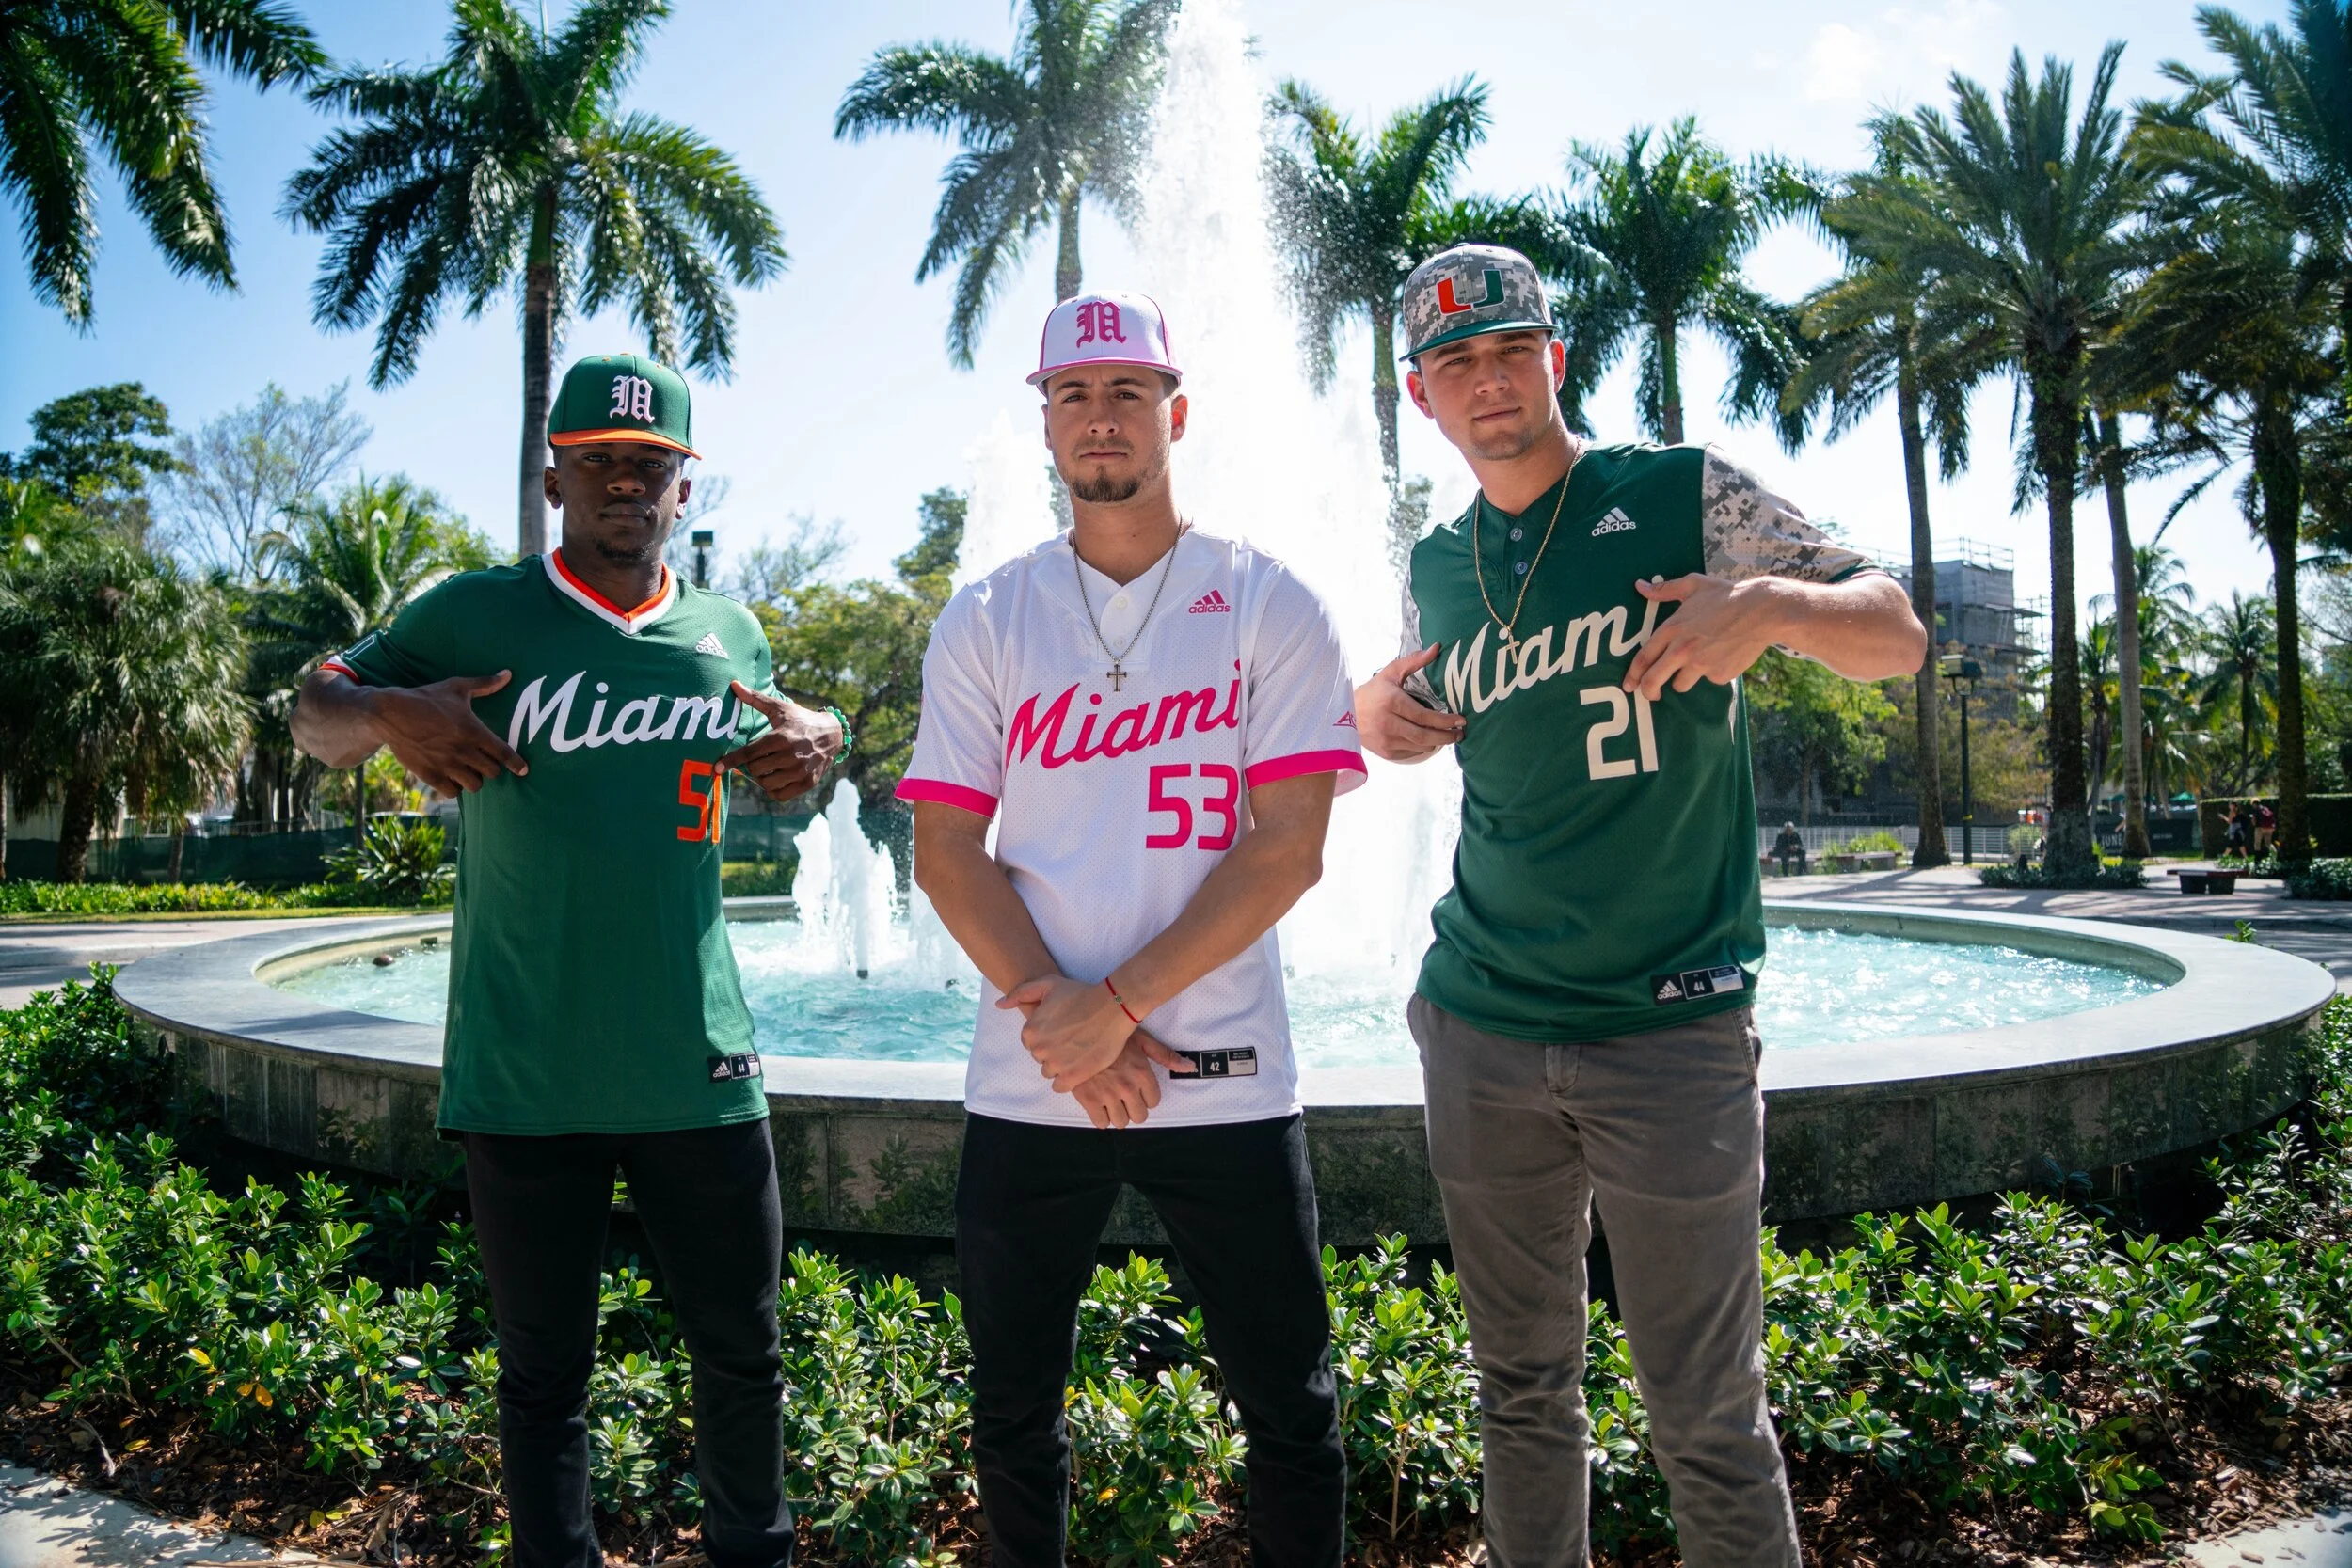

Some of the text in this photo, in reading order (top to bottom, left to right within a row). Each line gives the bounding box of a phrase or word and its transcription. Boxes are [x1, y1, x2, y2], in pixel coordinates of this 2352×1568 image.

[1437, 269, 1506, 316] U
[1076, 299, 1127, 348] M
[609, 374, 655, 424] M
[1592, 520, 1636, 536] adidas
[1188, 604, 1231, 614] adidas
[696, 644, 729, 659] adidas
[1444, 575, 1665, 715] Miami
[508, 670, 743, 752] Miami
[1004, 658, 1241, 771] Miami
[1580, 685, 1659, 780] 21
[677, 759, 723, 845] 51
[1146, 763, 1239, 851] 53
[1657, 990, 1682, 1000] adidas
[1693, 981, 1705, 992] 44
[1209, 1061, 1220, 1072] 42
